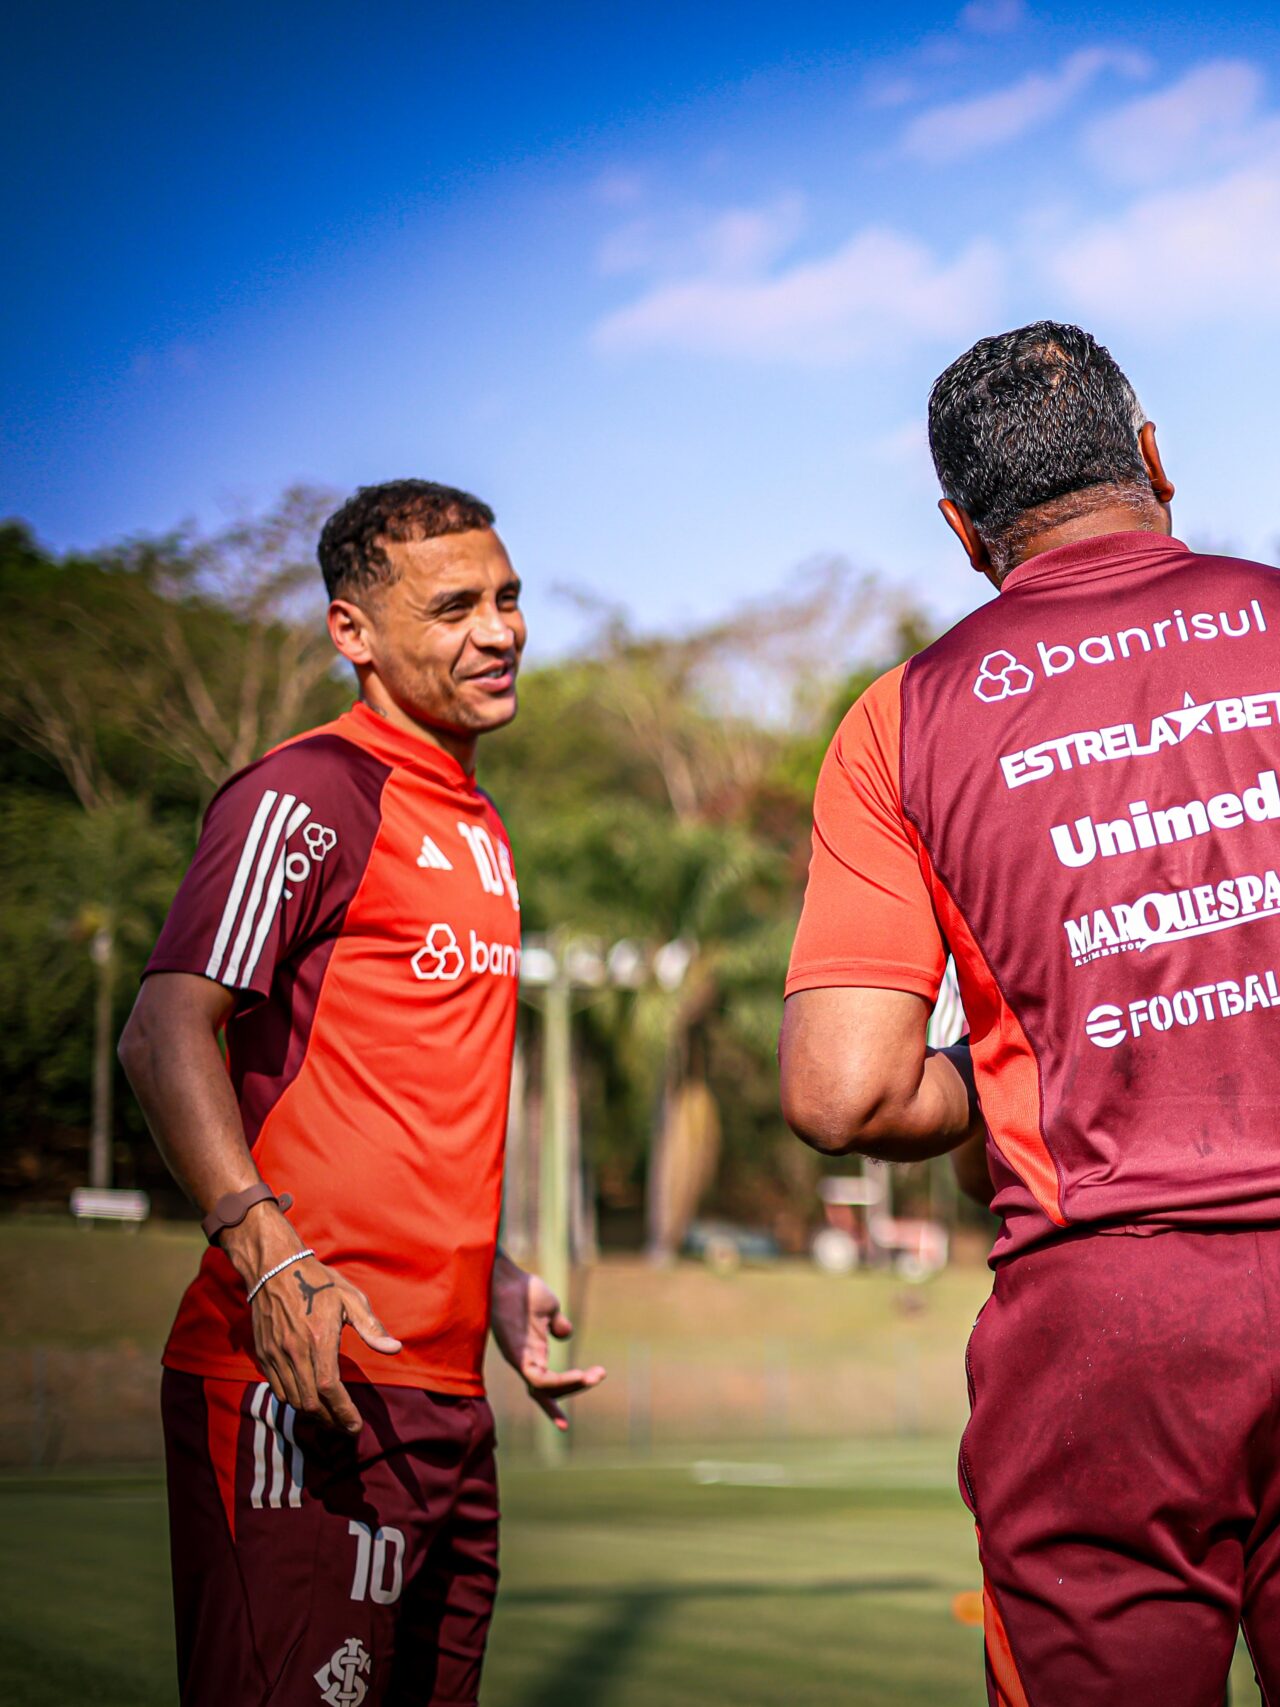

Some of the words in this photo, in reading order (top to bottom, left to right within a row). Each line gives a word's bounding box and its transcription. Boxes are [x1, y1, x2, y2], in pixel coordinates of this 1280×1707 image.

[1036, 600, 1267, 677] banrisul
[456, 821, 505, 896] 10
[470, 929, 521, 977] ban
[348, 1520, 406, 1605] 10
